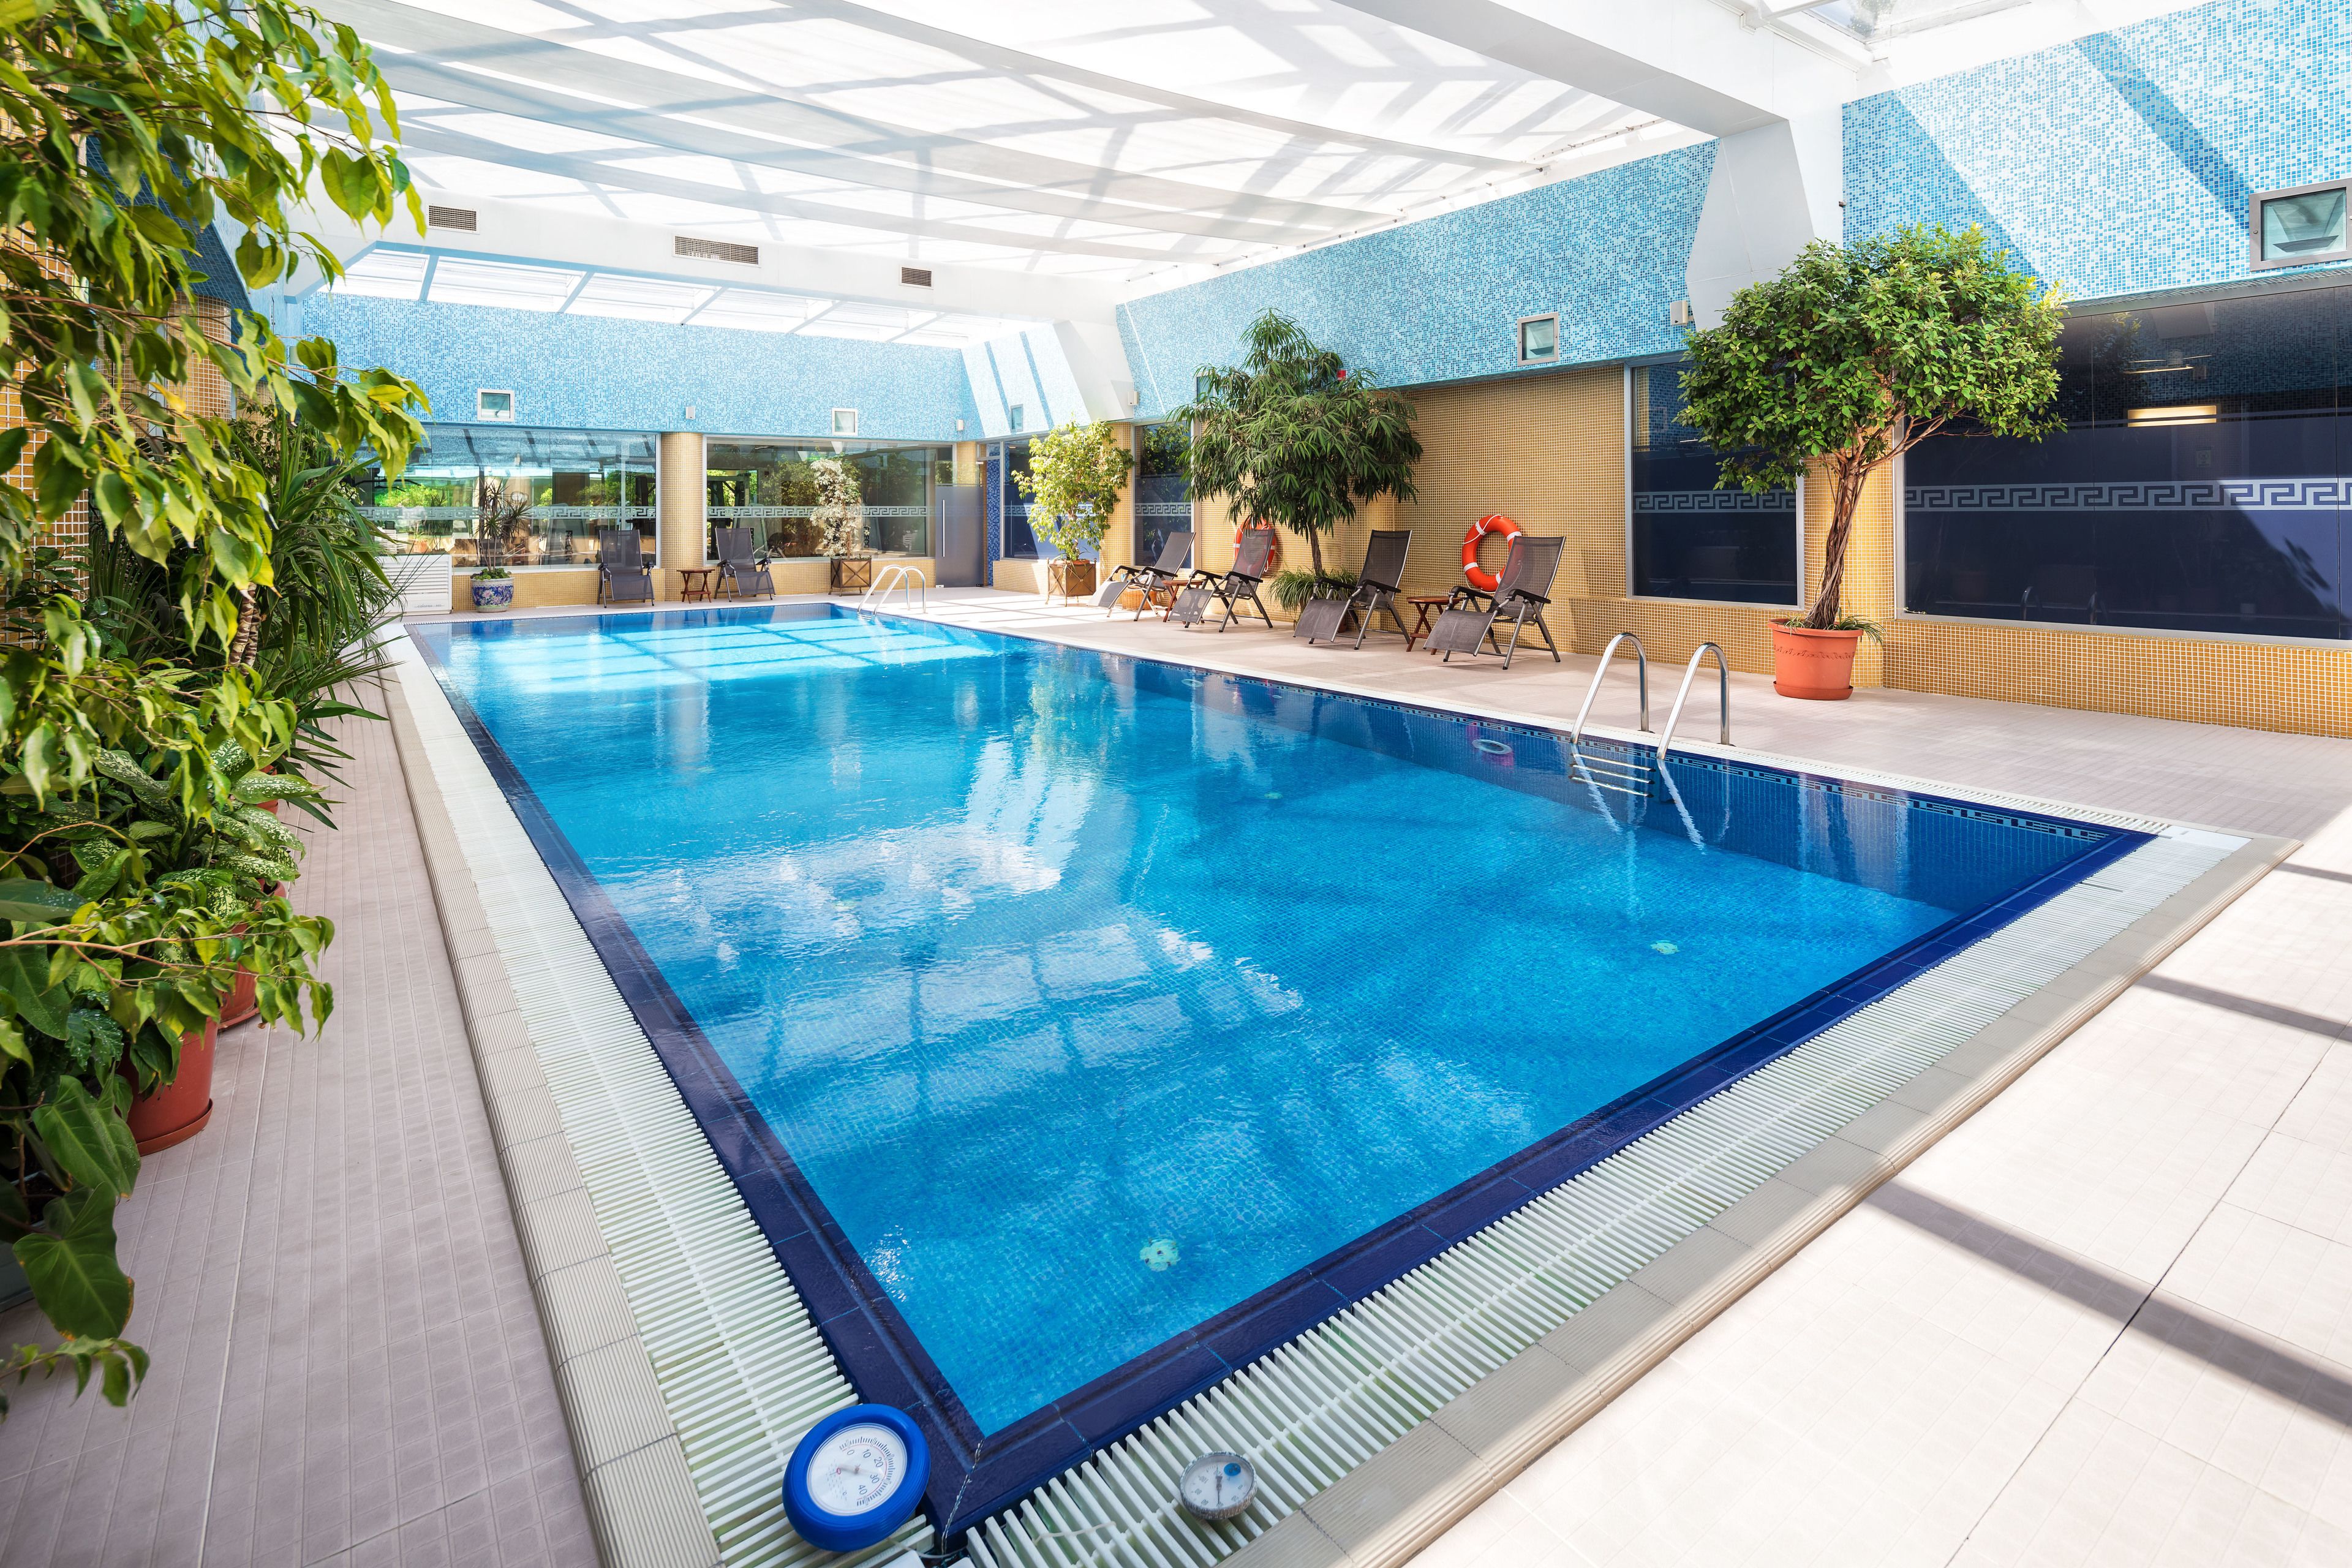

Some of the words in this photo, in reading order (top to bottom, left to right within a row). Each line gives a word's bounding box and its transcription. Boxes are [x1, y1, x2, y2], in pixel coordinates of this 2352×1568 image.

[862, 1449, 871, 1458] 10
[874, 1457, 883, 1468] 20
[870, 1474, 880, 1484] 30
[858, 1485, 868, 1495] 40
